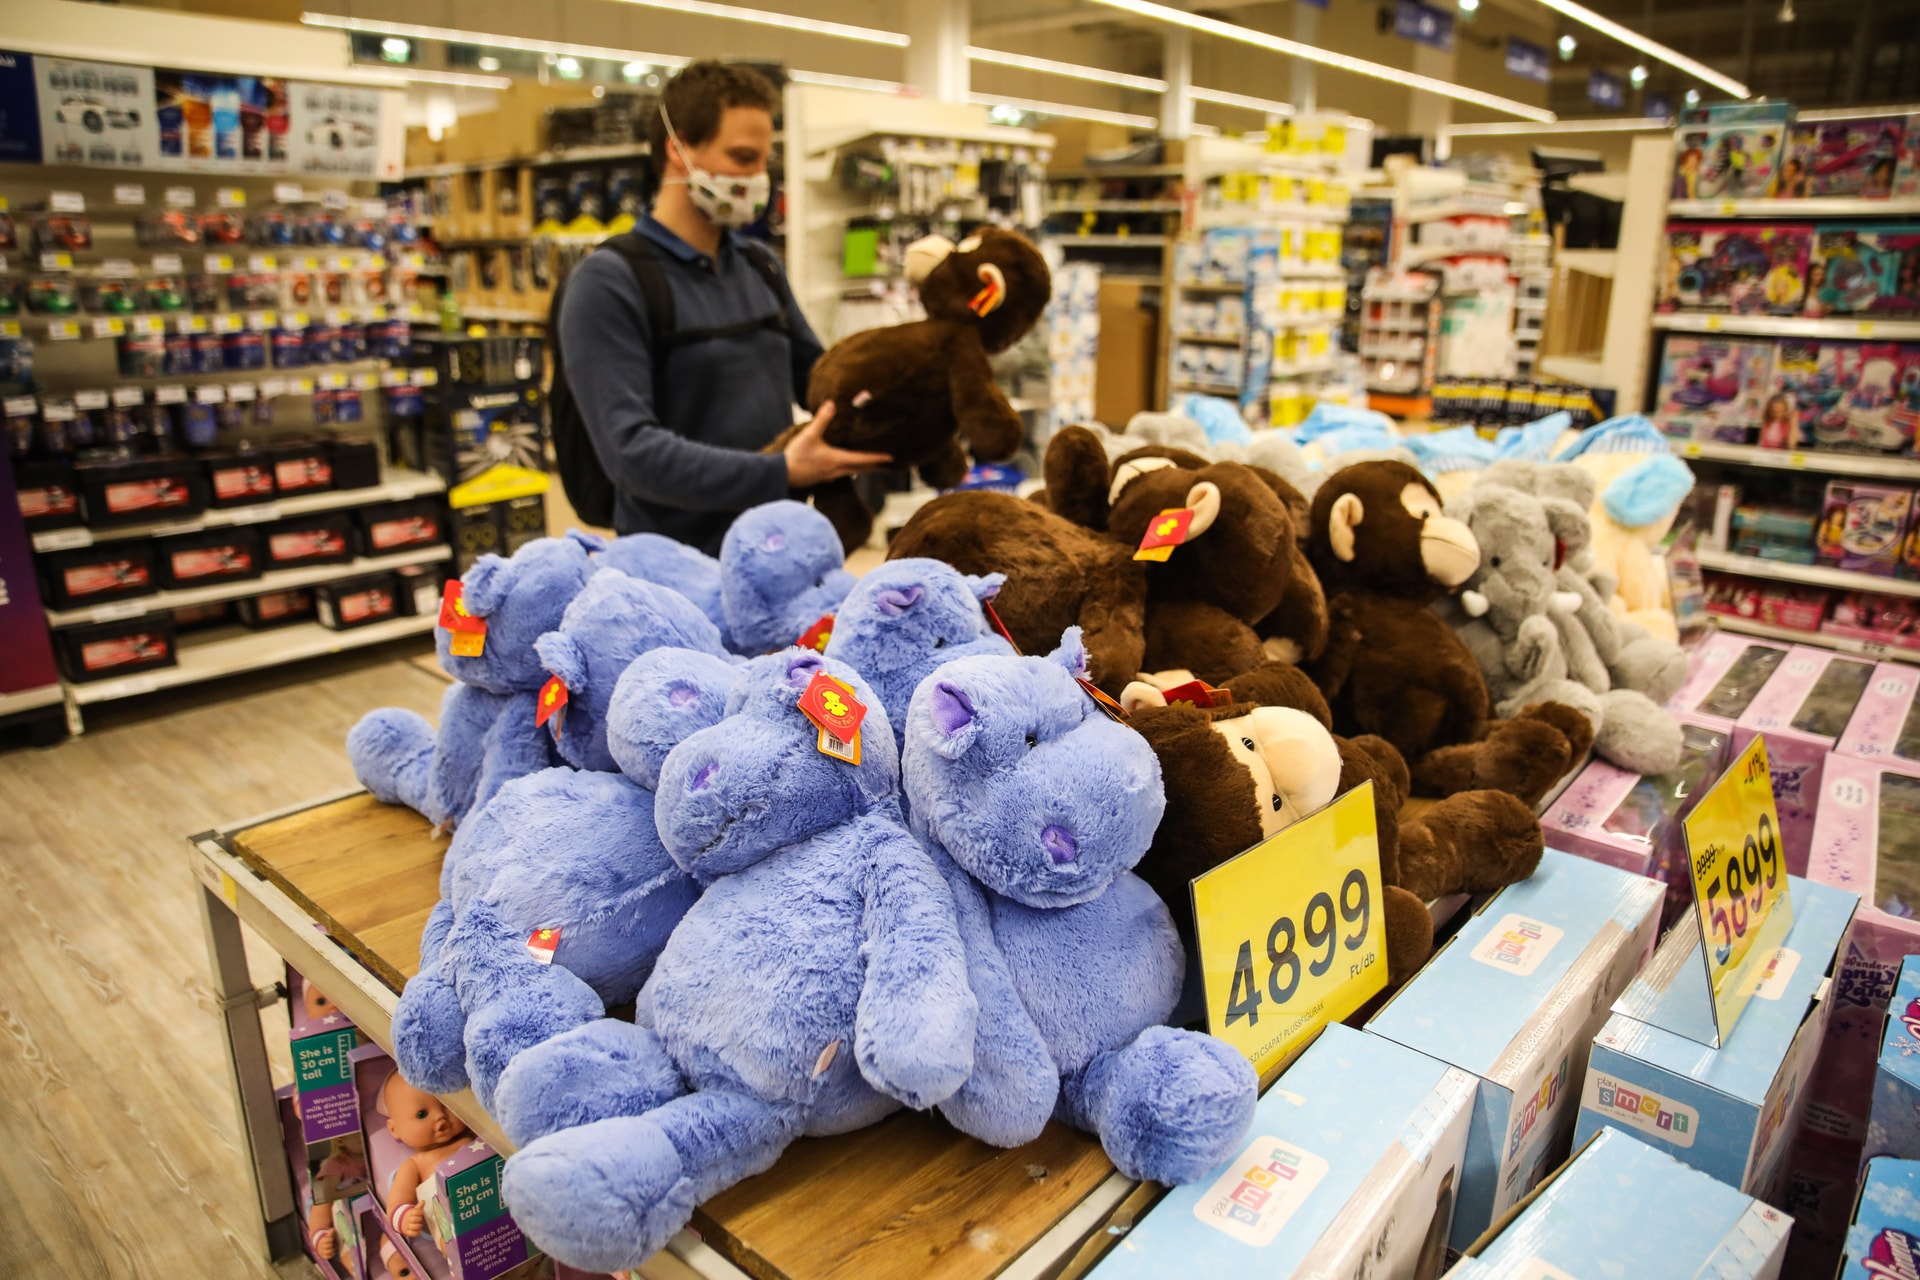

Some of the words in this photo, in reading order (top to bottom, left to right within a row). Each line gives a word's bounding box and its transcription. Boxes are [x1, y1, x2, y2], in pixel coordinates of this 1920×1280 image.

[1696, 843, 1716, 881] 9999
[1707, 813, 1777, 966] 5899
[1225, 869, 1370, 1028] 4899
[1349, 952, 1376, 980] Ft/db
[299, 1049, 320, 1060] She
[322, 1046, 333, 1055] is
[1260, 1033, 1284, 1057] CSAPAT
[301, 1060, 316, 1070] 30
[318, 1057, 336, 1066] cm
[302, 1069, 322, 1080] tall
[1597, 1077, 1617, 1094] play
[313, 1095, 336, 1105] Watch
[337, 1092, 350, 1100] the
[306, 1105, 322, 1114] milk
[306, 1112, 324, 1120] from
[325, 1108, 337, 1116] her
[1600, 1088, 1688, 1132] smart
[317, 1116, 337, 1125] while
[324, 1120, 347, 1129] drinks
[455, 1183, 478, 1198] She
[480, 1176, 491, 1187] is
[1229, 1148, 1301, 1226] smart
[458, 1196, 473, 1209] 30
[476, 1188, 494, 1200] cm
[459, 1204, 480, 1220] tall
[464, 1245, 481, 1258] milk
[482, 1228, 519, 1249] disappear
[471, 1231, 496, 1246] Watch
[496, 1223, 510, 1234] the
[464, 1253, 483, 1265] from
[484, 1246, 497, 1256] her
[499, 1234, 521, 1248] bottle
[476, 1254, 497, 1267] while
[499, 1246, 511, 1256] she
[484, 1256, 507, 1271] drinks
